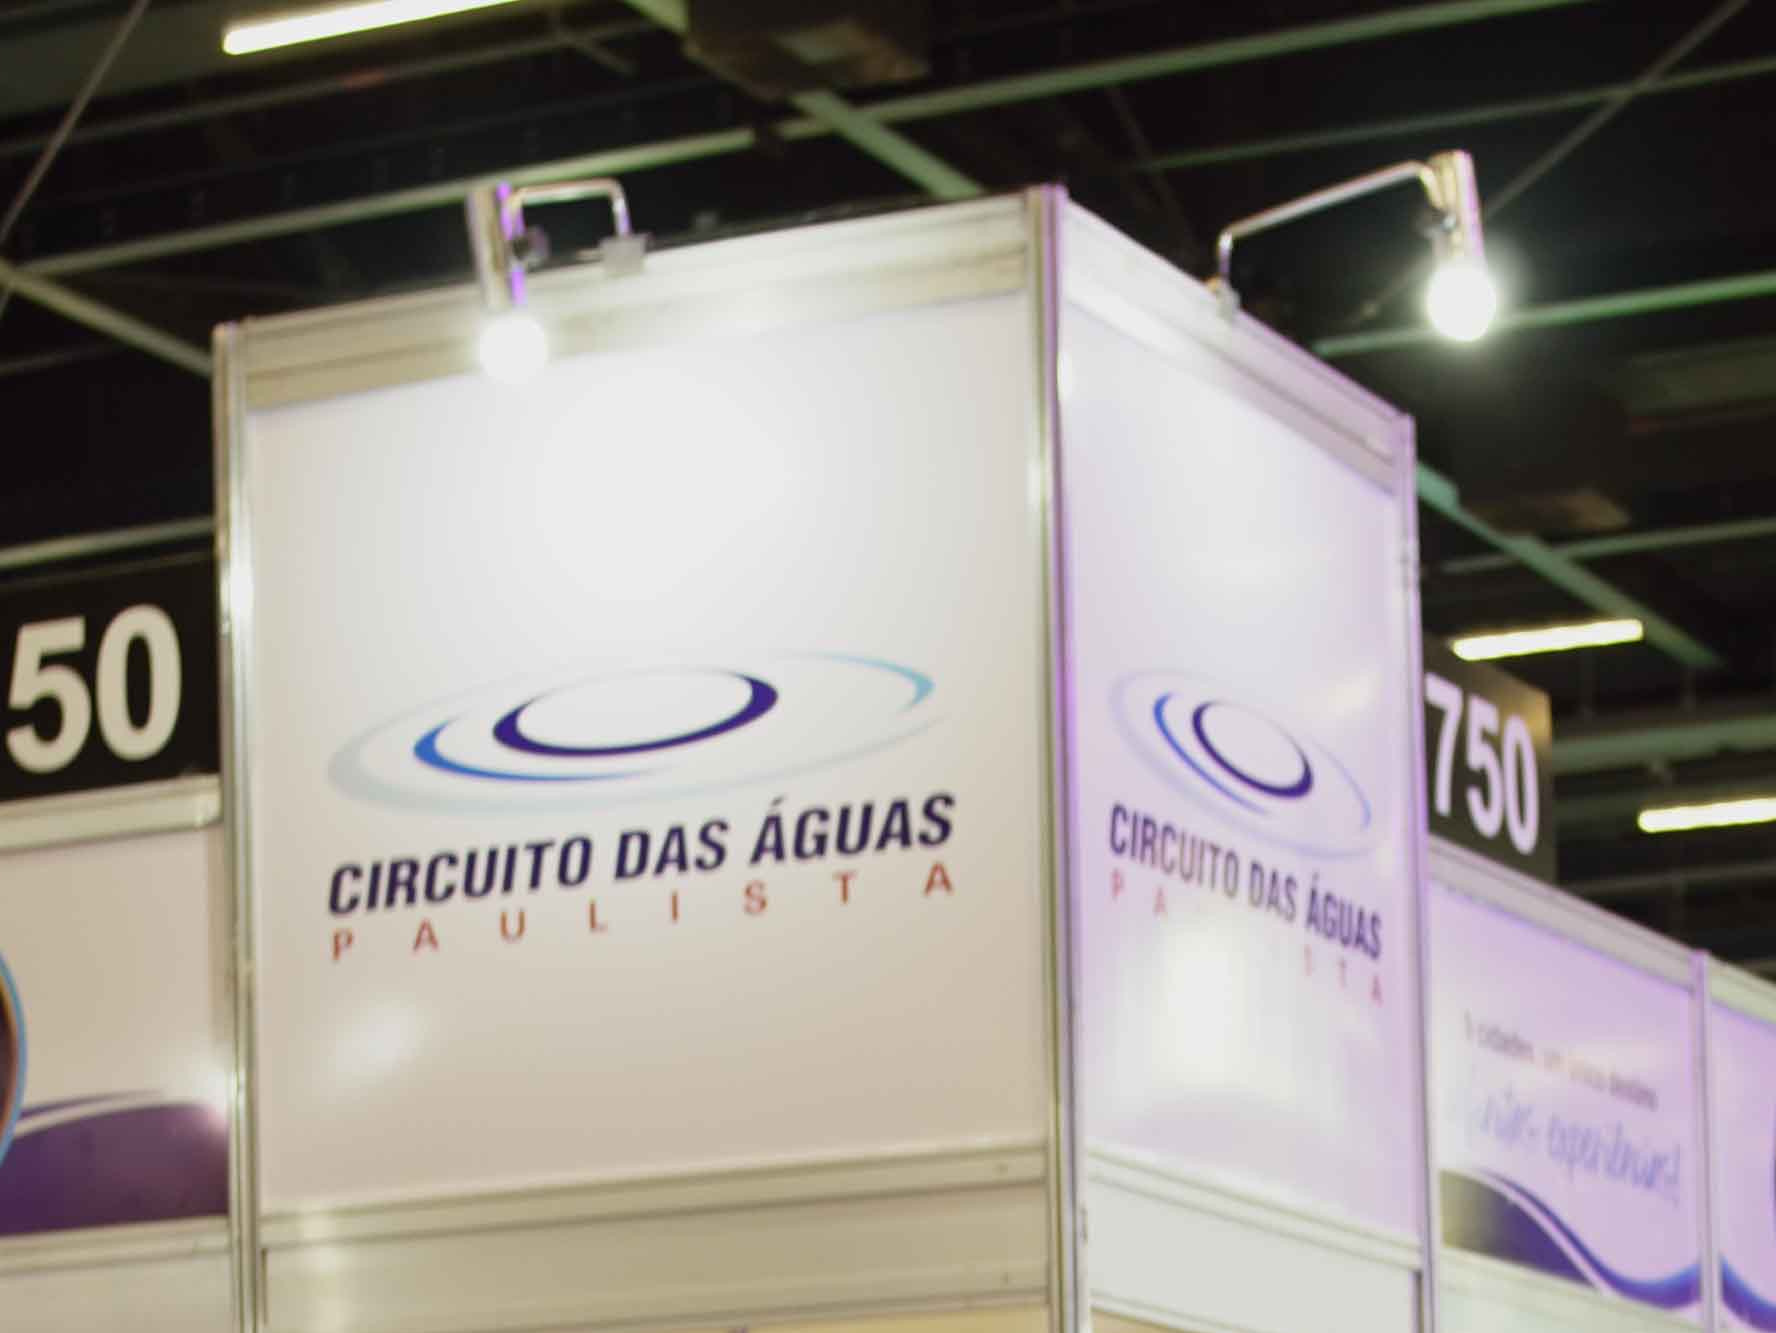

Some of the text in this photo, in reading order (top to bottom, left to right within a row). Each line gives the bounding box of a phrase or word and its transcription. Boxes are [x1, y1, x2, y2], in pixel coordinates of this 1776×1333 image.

[1425, 672, 1540, 856] 750
[328, 796, 956, 916] CIRCUITO DAS ÁGUAS
[331, 860, 954, 962] PAULISTA
[1109, 803, 1382, 961] CIRCUITO DAS ÁGUAS
